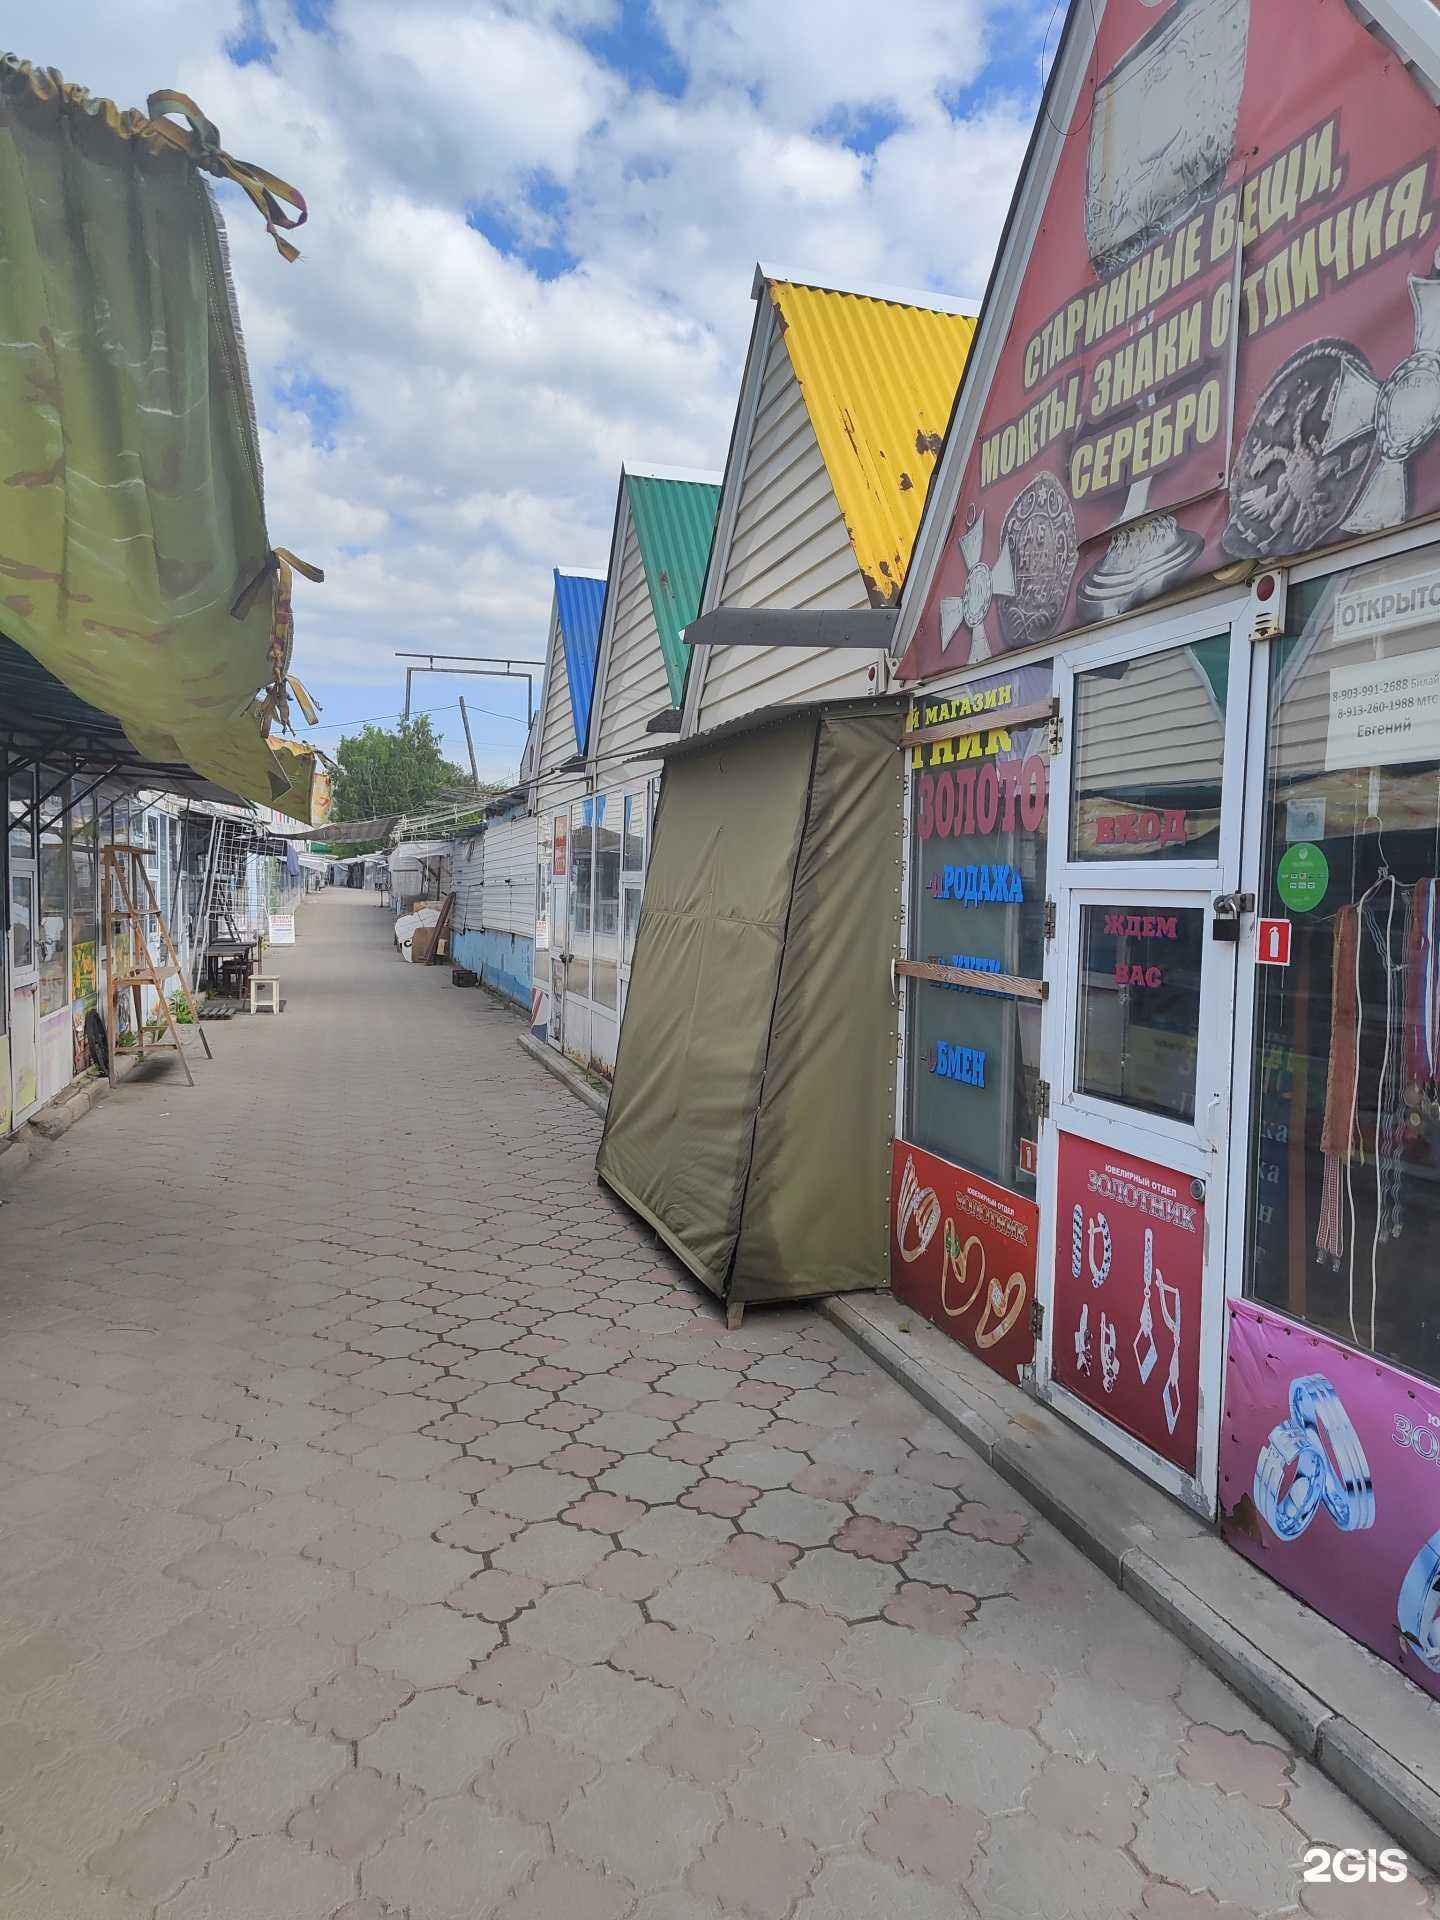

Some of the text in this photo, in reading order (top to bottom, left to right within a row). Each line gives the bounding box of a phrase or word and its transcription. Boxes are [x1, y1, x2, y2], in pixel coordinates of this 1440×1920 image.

[1024, 120, 1342, 388] СТАРИННЫЕ ВЕЩИ,
[981, 376, 1082, 487] МОНЕТЫ,
[1091, 300, 1203, 416] ЗНАКИ
[1071, 379, 1220, 499] СЕРЕБРО
[925, 684, 1012, 725] МАГАЗИН
[1357, 716, 1412, 737] Евгений
[918, 754, 1046, 841] ЗОЛОТО
[1096, 810, 1188, 848] ВХОД
[1104, 914, 1178, 940] ЖДЕМ
[1115, 962, 1163, 988] ВАС
[1152, 1181, 1177, 1197] ОТДЕЛ
